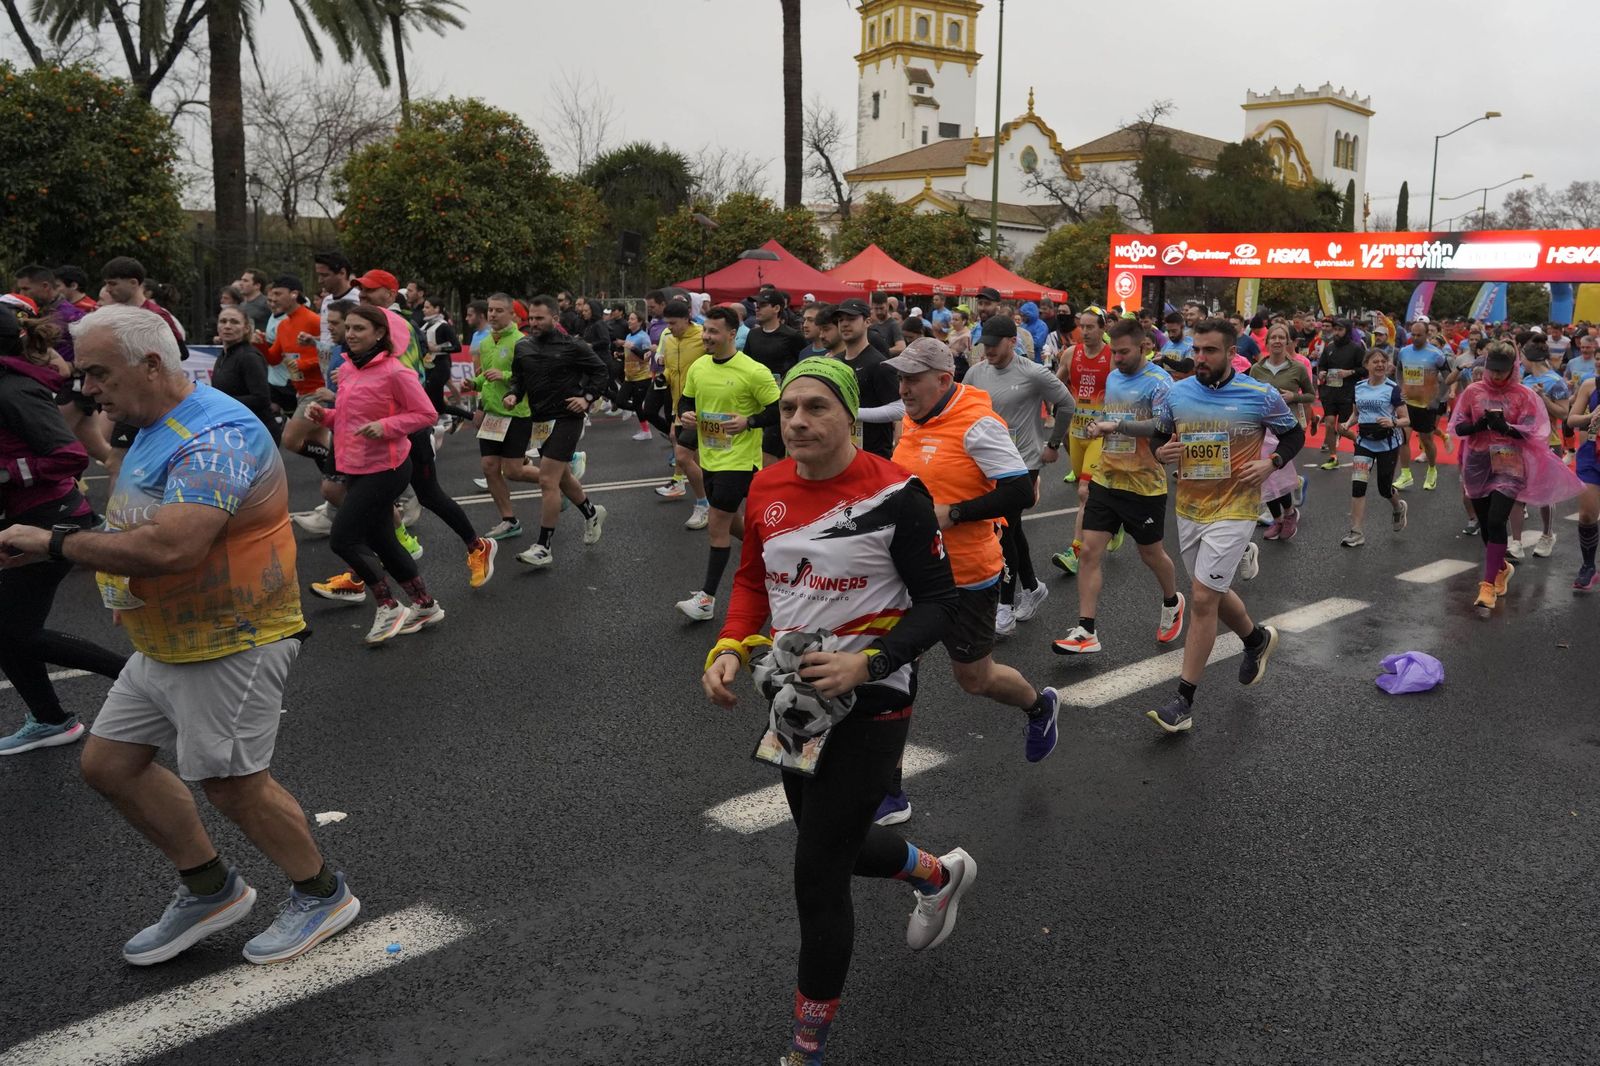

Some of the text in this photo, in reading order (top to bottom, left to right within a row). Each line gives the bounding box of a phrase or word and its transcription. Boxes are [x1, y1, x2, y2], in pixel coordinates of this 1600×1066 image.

[1186, 249, 1231, 260] Sprinter
[1379, 241, 1453, 256] maratón
[1546, 246, 1600, 263] HOKA
[1229, 257, 1261, 265] HYUNDAI
[1267, 248, 1311, 263] HOKA
[1396, 254, 1454, 269] sevilla
[1080, 373, 1096, 385] JESÚS
[1079, 386, 1094, 397] ESP
[1185, 444, 1221, 459] 16967
[803, 1001, 830, 1010] KEEP
